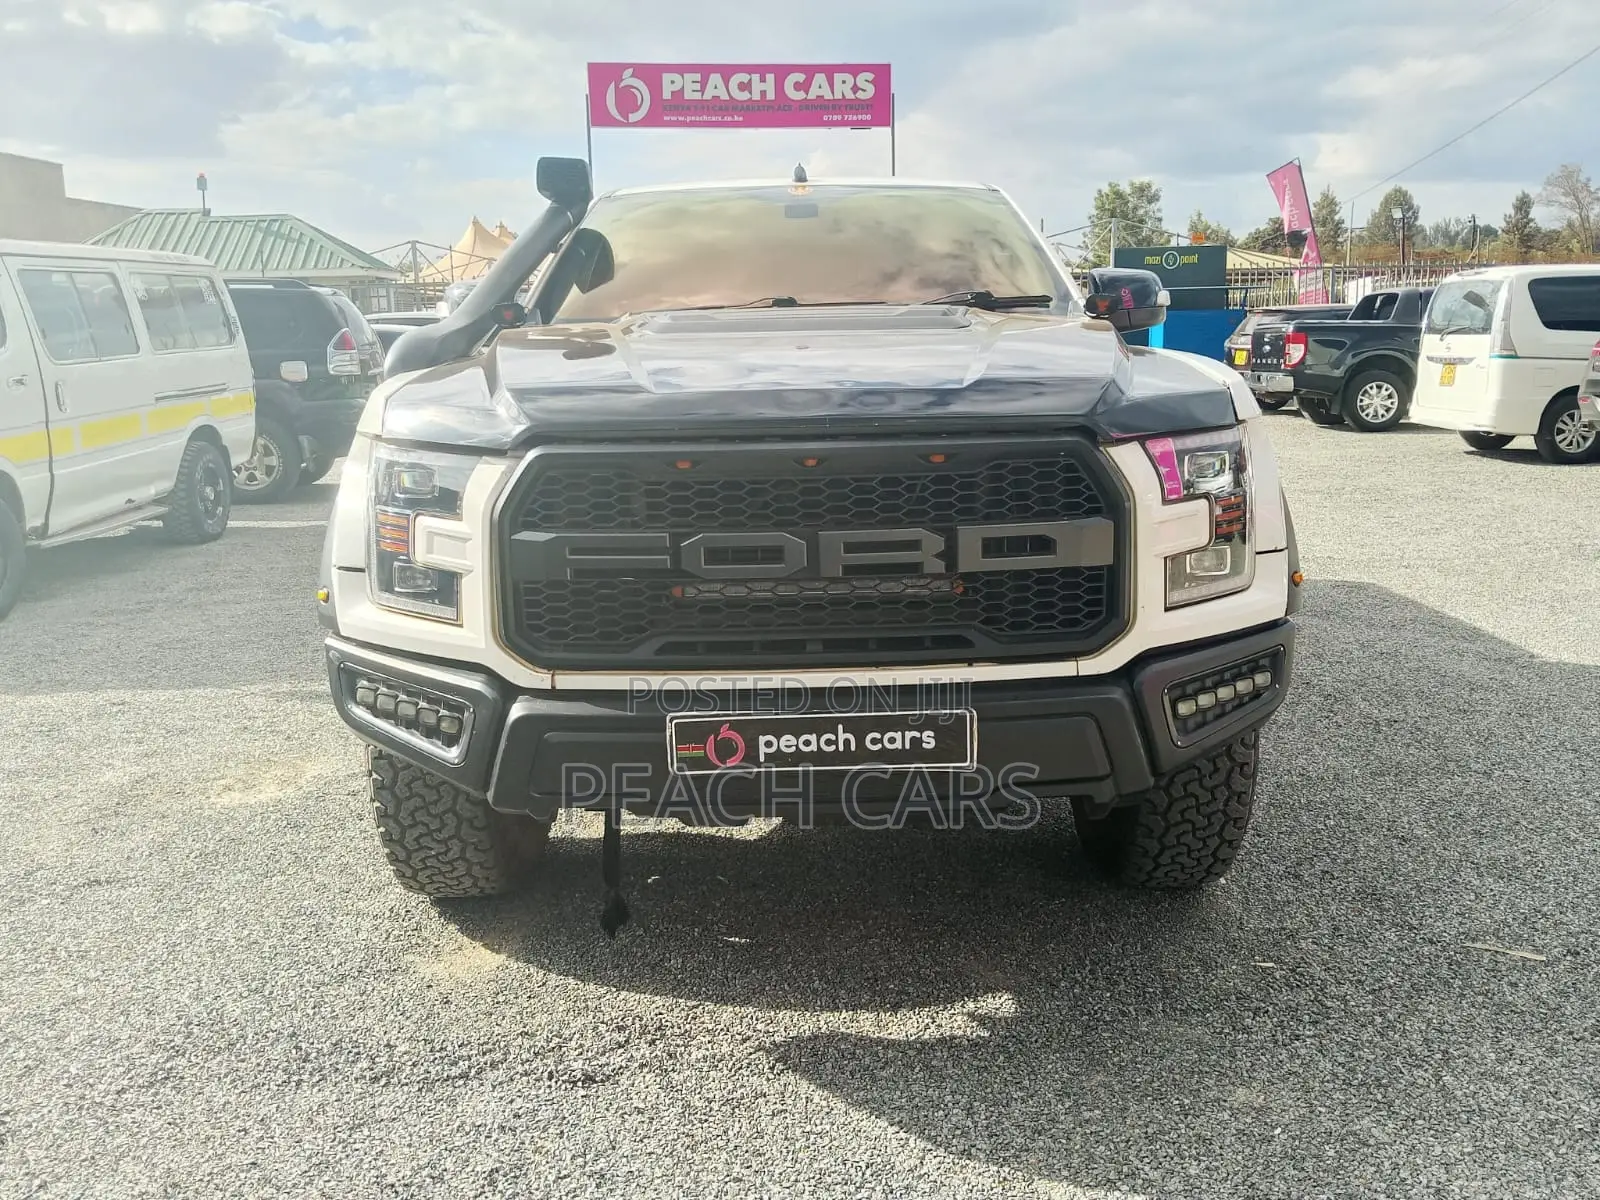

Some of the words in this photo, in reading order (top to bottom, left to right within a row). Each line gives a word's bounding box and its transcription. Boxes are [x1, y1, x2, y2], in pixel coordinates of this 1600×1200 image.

[661, 71, 776, 101] PEACH
[784, 72, 876, 101] CARS
[1180, 253, 1199, 267] point
[511, 516, 1114, 578] FORD
[759, 723, 856, 761] peach
[866, 725, 936, 751] cars
